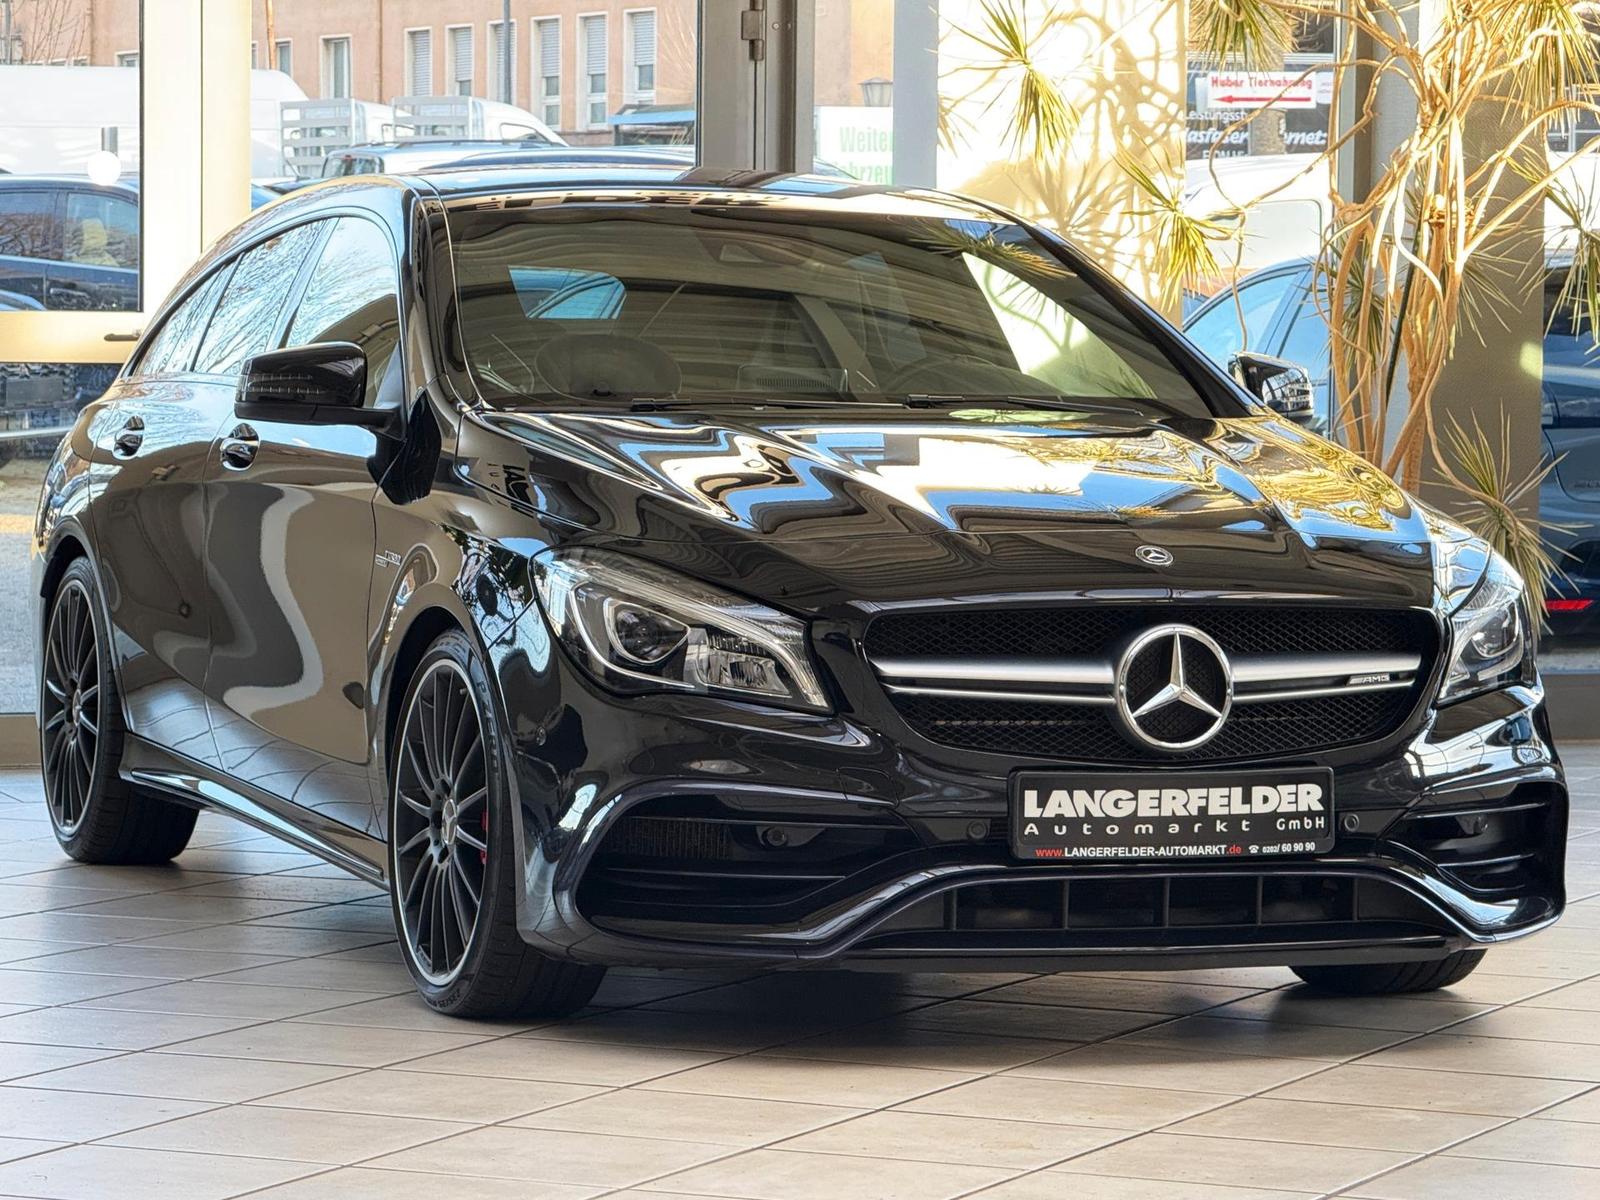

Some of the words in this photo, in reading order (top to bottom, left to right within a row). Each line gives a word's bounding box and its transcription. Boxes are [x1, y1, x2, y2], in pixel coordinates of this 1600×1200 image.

[1249, 76, 1313, 90] Tiernahrng
[1024, 783, 1324, 818] LANGERFELDER
[1024, 819, 1250, 835] Automarkt
[1276, 816, 1325, 830] GmbH
[1034, 844, 1243, 858] www.LANGERFELDER-AUTOMARKT.de
[1281, 842, 1292, 853] 60
[1293, 842, 1304, 852] 90
[1305, 841, 1315, 851] 90
